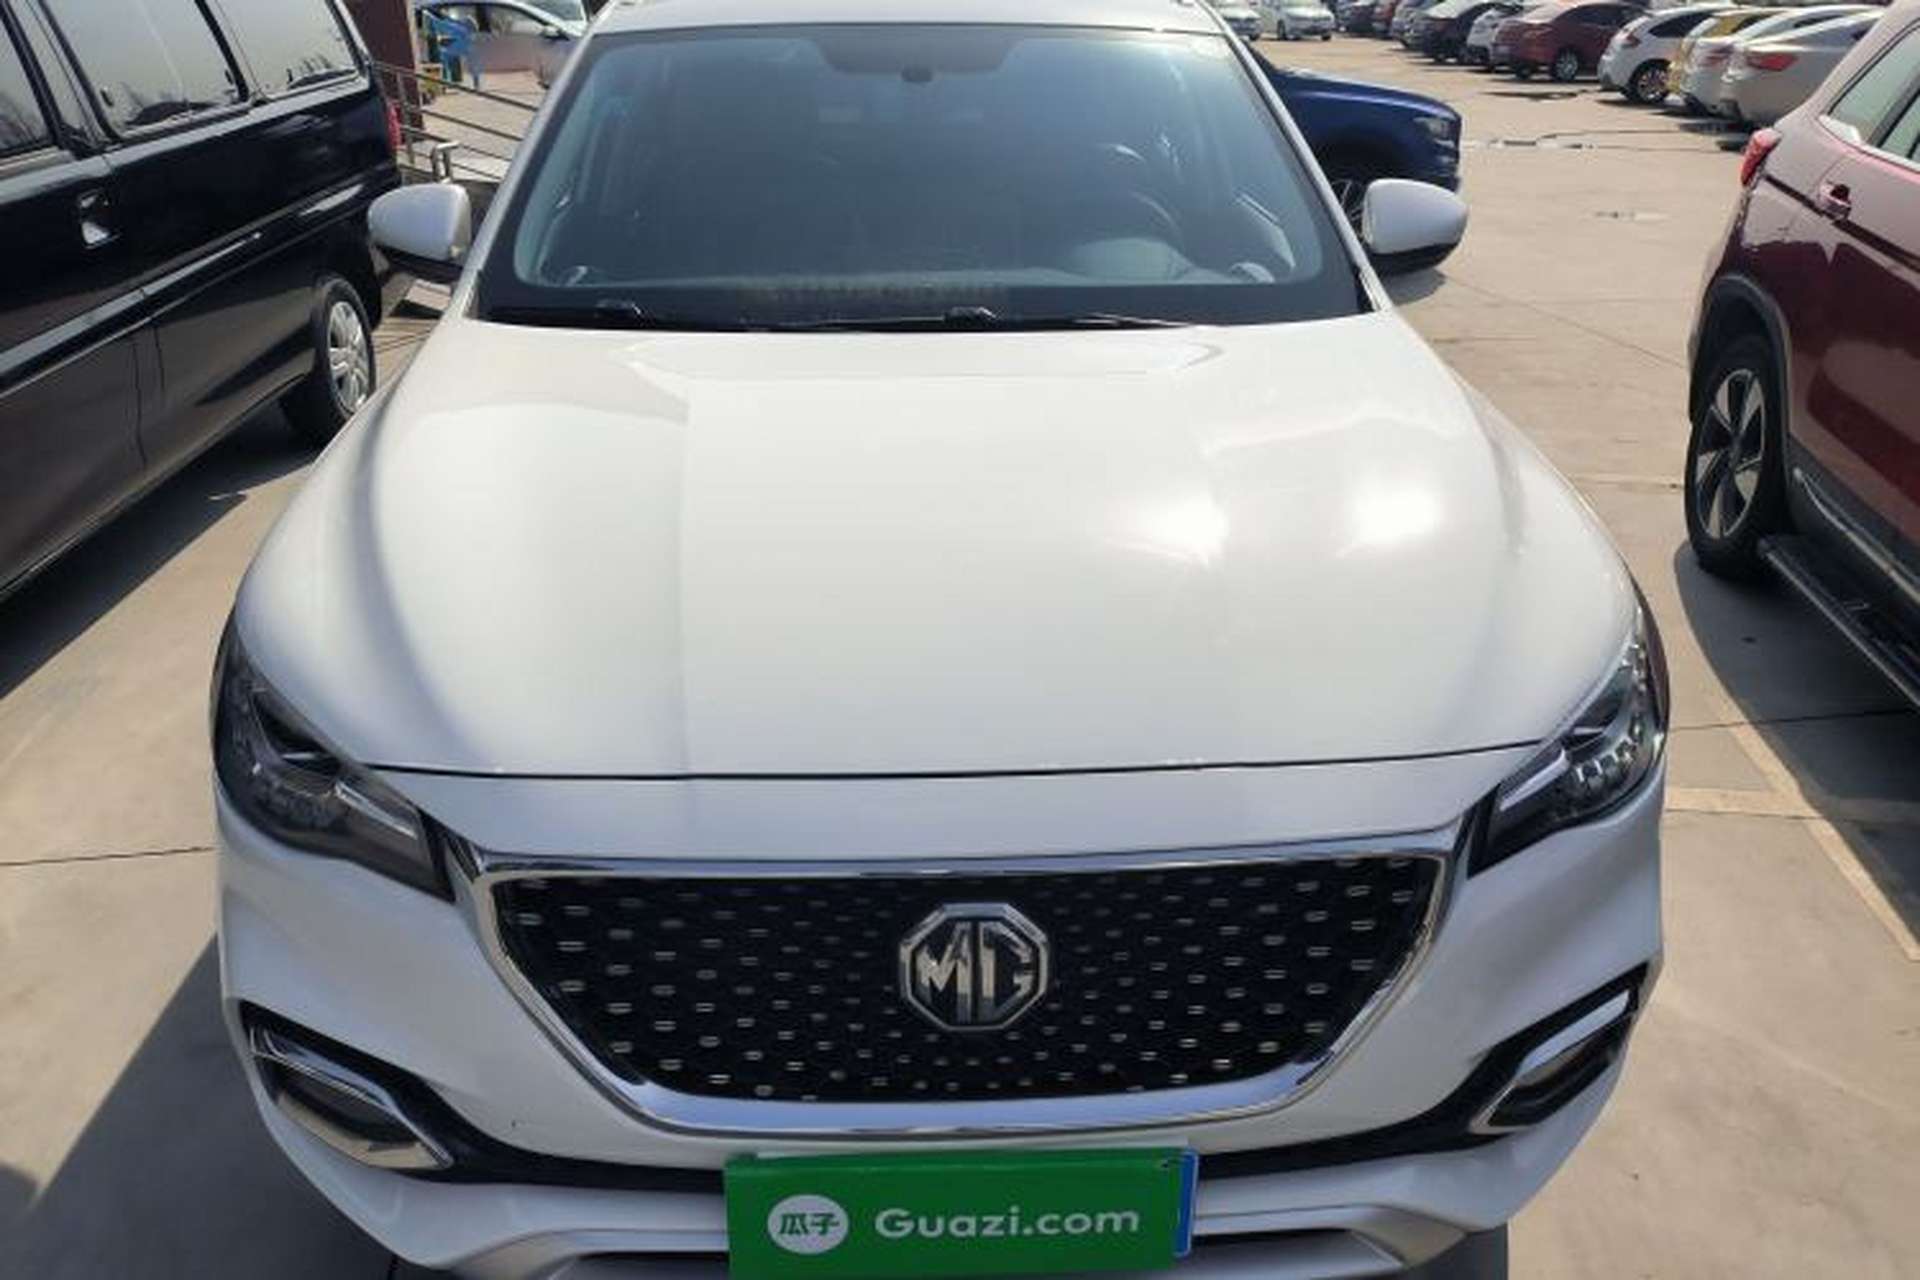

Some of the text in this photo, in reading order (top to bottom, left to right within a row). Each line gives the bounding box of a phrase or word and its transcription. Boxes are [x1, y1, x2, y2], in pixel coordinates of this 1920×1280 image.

[915, 920, 1034, 1025] MG
[779, 1212, 840, 1236] 瓜子
[874, 1204, 1140, 1239] Guazi.com
